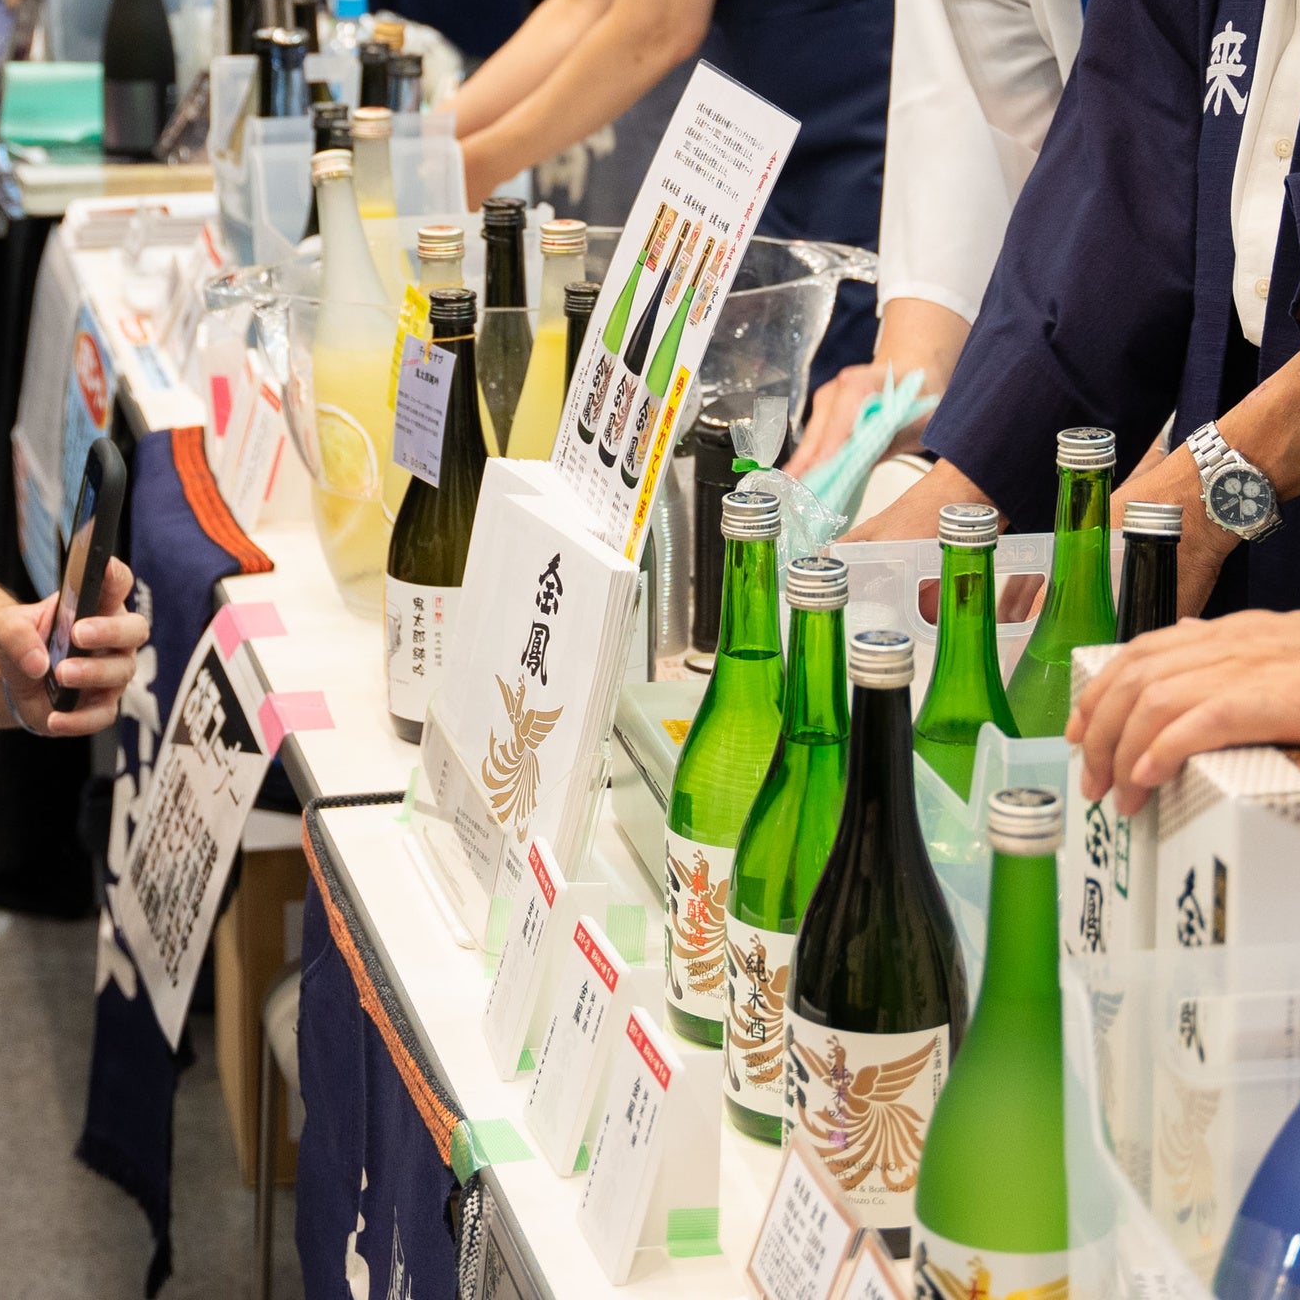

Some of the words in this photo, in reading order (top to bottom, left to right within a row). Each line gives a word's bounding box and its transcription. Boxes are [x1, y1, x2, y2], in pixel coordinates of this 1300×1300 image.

[521, 553, 564, 686] 金鳳
[686, 868, 709, 954] 本醸造
[707, 991, 725, 1000] Shuz
[744, 953, 769, 1044] 純米酒
